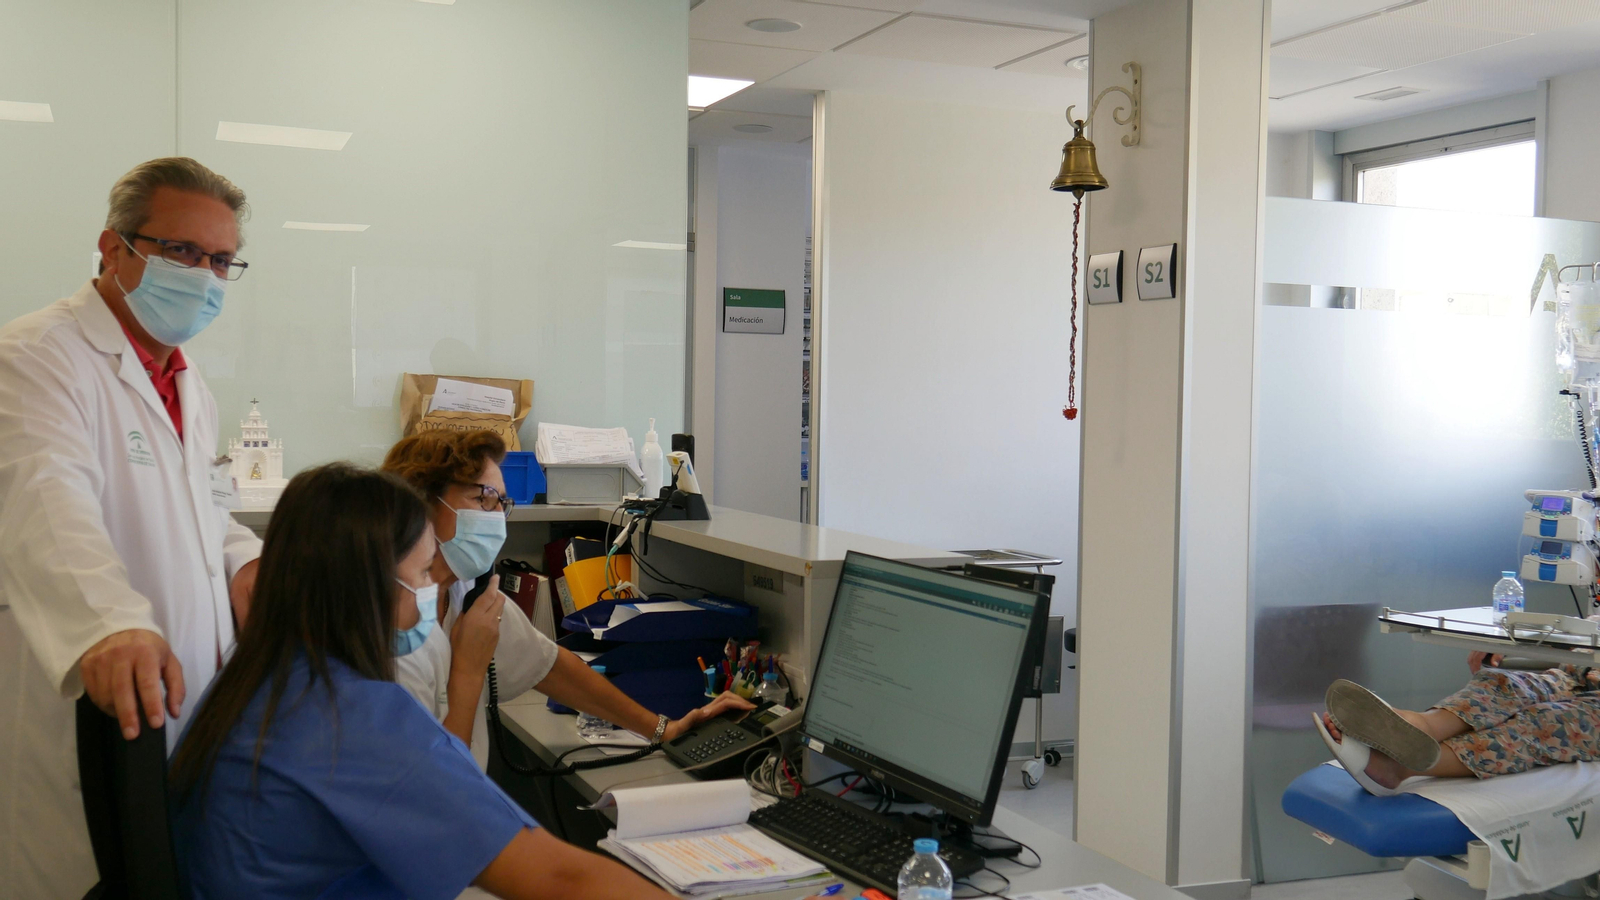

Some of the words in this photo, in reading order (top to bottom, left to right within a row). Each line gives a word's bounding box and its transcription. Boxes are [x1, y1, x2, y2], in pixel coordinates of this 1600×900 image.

[1093, 267, 1110, 289] S1
[1145, 261, 1164, 284] S2
[729, 316, 764, 324] Medicación
